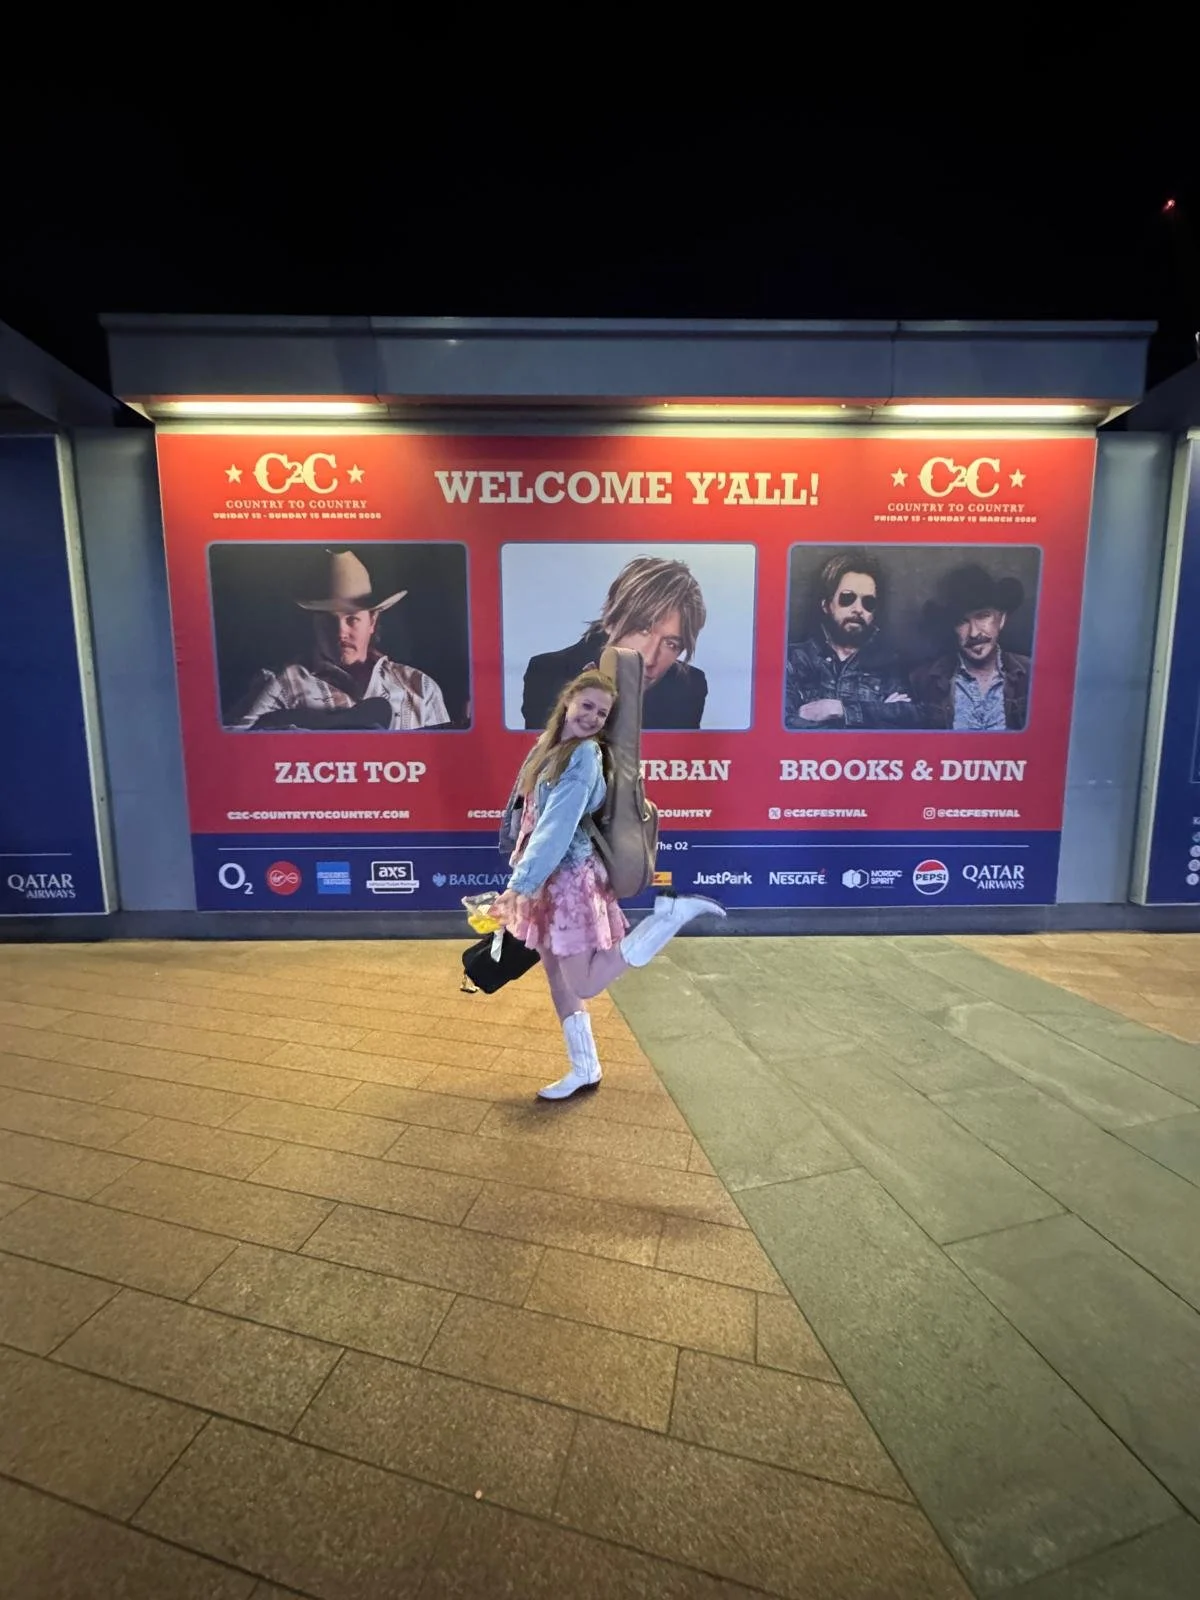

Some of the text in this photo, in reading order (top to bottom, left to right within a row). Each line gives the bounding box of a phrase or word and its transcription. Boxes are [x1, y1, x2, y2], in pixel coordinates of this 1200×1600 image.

[252, 453, 338, 494] C2C
[917, 456, 1001, 498] C2C
[434, 470, 819, 506] WELCOME Y’ALL!
[225, 499, 367, 509] COUNTRY TO COUNTRY
[887, 503, 1025, 513] COUNTRY TO COUNTRY
[274, 761, 427, 784] ZACH TOP
[779, 759, 1027, 782] BROOKS & DUNN
[227, 810, 410, 820] C2C-COUNTRYTOCOUNTRY.COM
[218, 862, 254, 895] O2
[378, 866, 407, 880] axs
[693, 871, 753, 885] JustPark
[870, 870, 903, 878] NORDIC
[915, 872, 947, 882] PEPSI
[962, 864, 1025, 882] QATAR
[7, 873, 75, 892] QATAR
[870, 877, 895, 885] SPIRIT
[977, 880, 1025, 890] AIRWAYS
[26, 888, 76, 899] AIRWAYS
